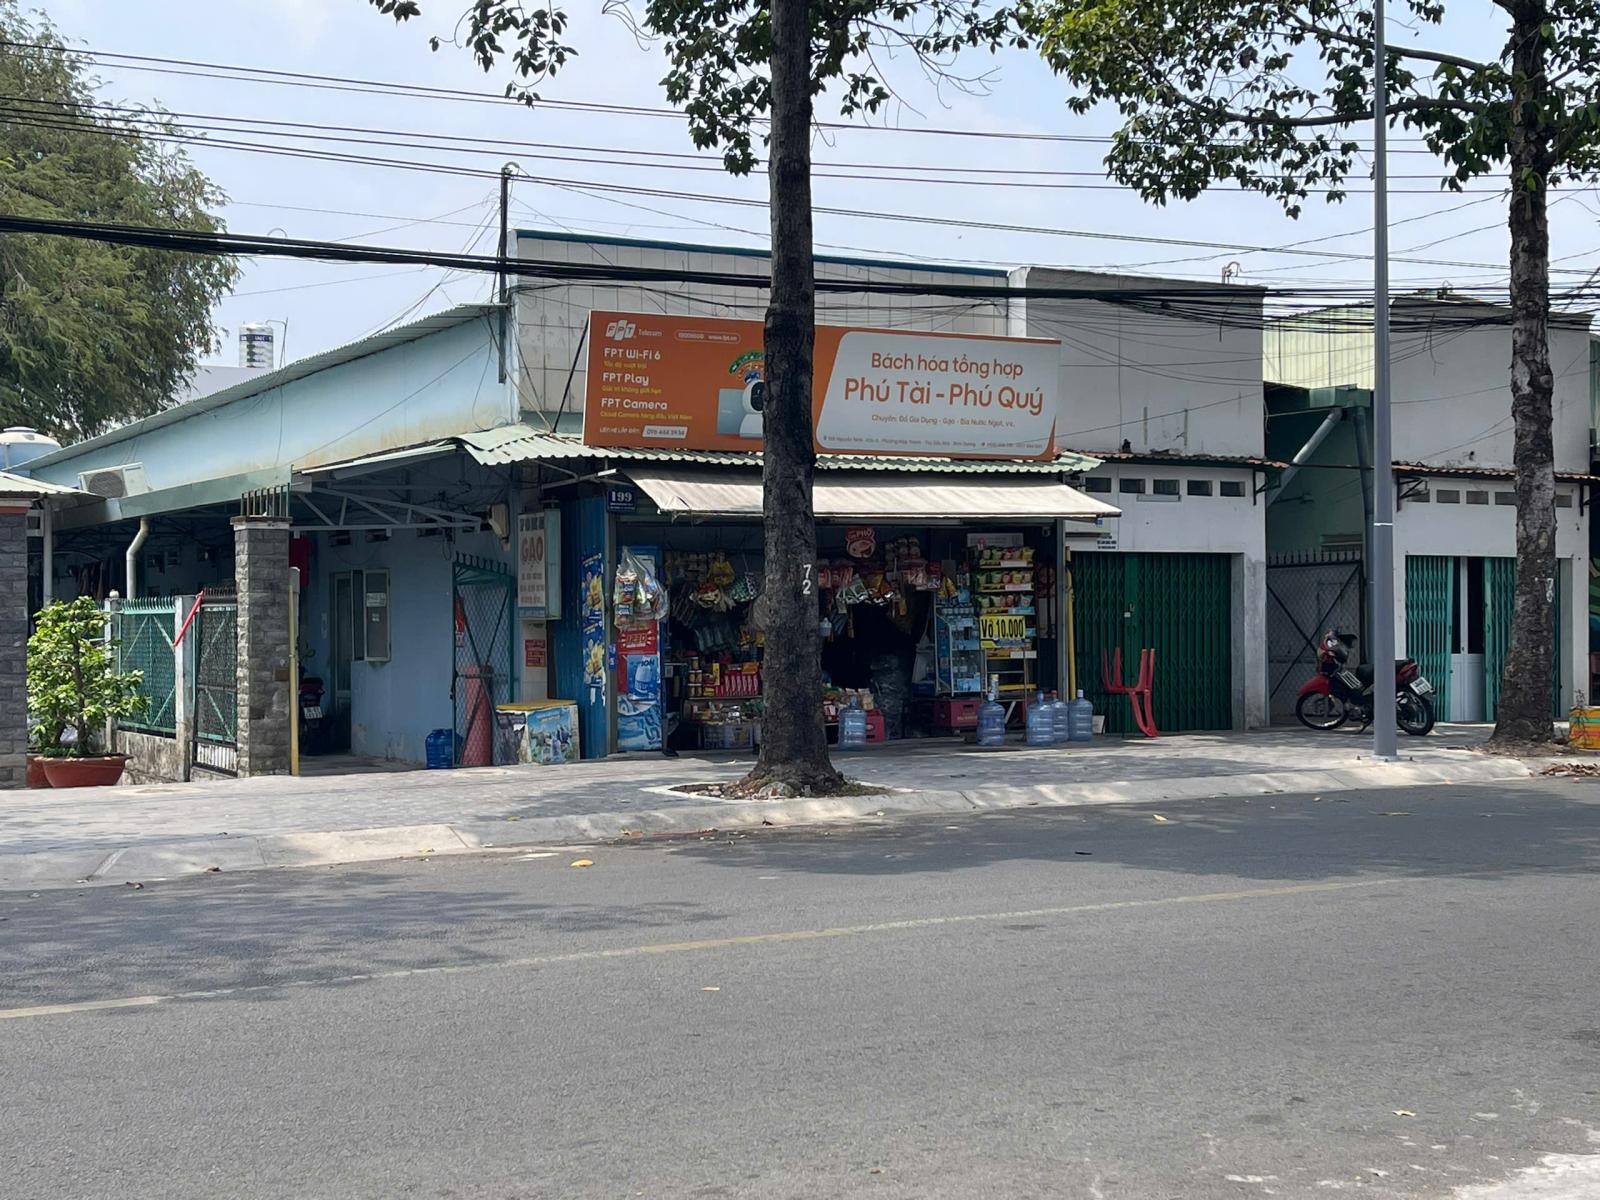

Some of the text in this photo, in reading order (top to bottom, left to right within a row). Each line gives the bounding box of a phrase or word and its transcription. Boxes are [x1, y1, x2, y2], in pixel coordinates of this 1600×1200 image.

[604, 347, 661, 360] FPT Wi-Fi 6
[872, 353, 1023, 380] Bách hóa tổng hợp
[602, 372, 649, 387] FPT Play
[601, 398, 668, 411] FPT Camera
[844, 377, 890, 401] Phú
[897, 381, 930, 404] Tài
[949, 383, 992, 407] Phú
[998, 386, 1043, 416] Quý
[612, 491, 632, 502] 199
[802, 564, 812, 595] 72
[996, 618, 1024, 638] 10.000
